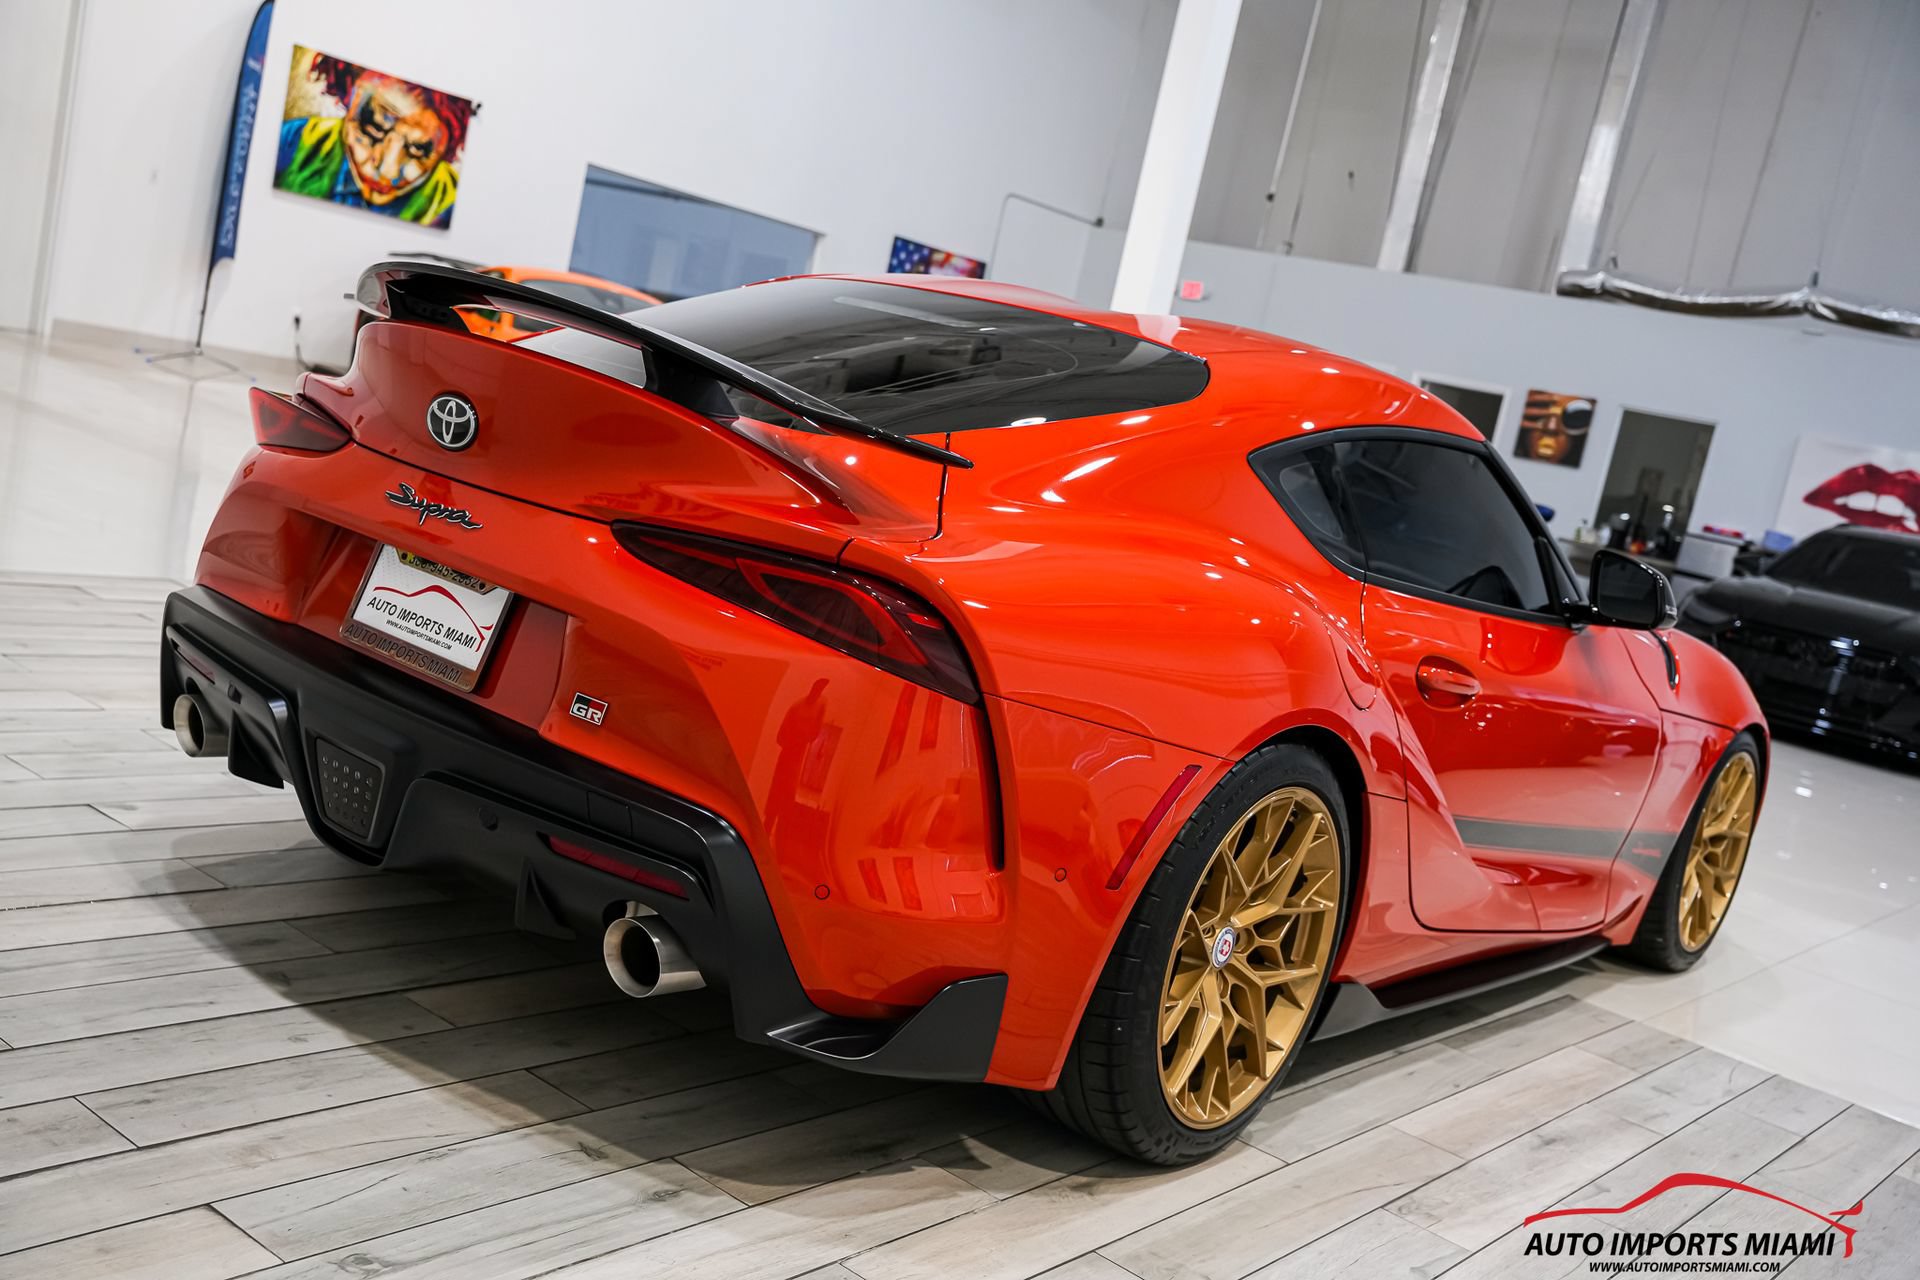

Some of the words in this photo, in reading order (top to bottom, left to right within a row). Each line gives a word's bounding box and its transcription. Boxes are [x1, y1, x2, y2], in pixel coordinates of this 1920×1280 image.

[385, 482, 483, 529] Supra
[366, 596, 398, 617] AUTO
[397, 607, 444, 636] IMPORTS
[444, 626, 478, 649] MIAMI
[386, 619, 453, 650] WWW.AUTOIMPORTSMIAMI.COM
[345, 624, 378, 646] AUTO
[375, 636, 429, 669] IMPORTS
[425, 659, 463, 684] MIAMI
[573, 703, 602, 723] GR
